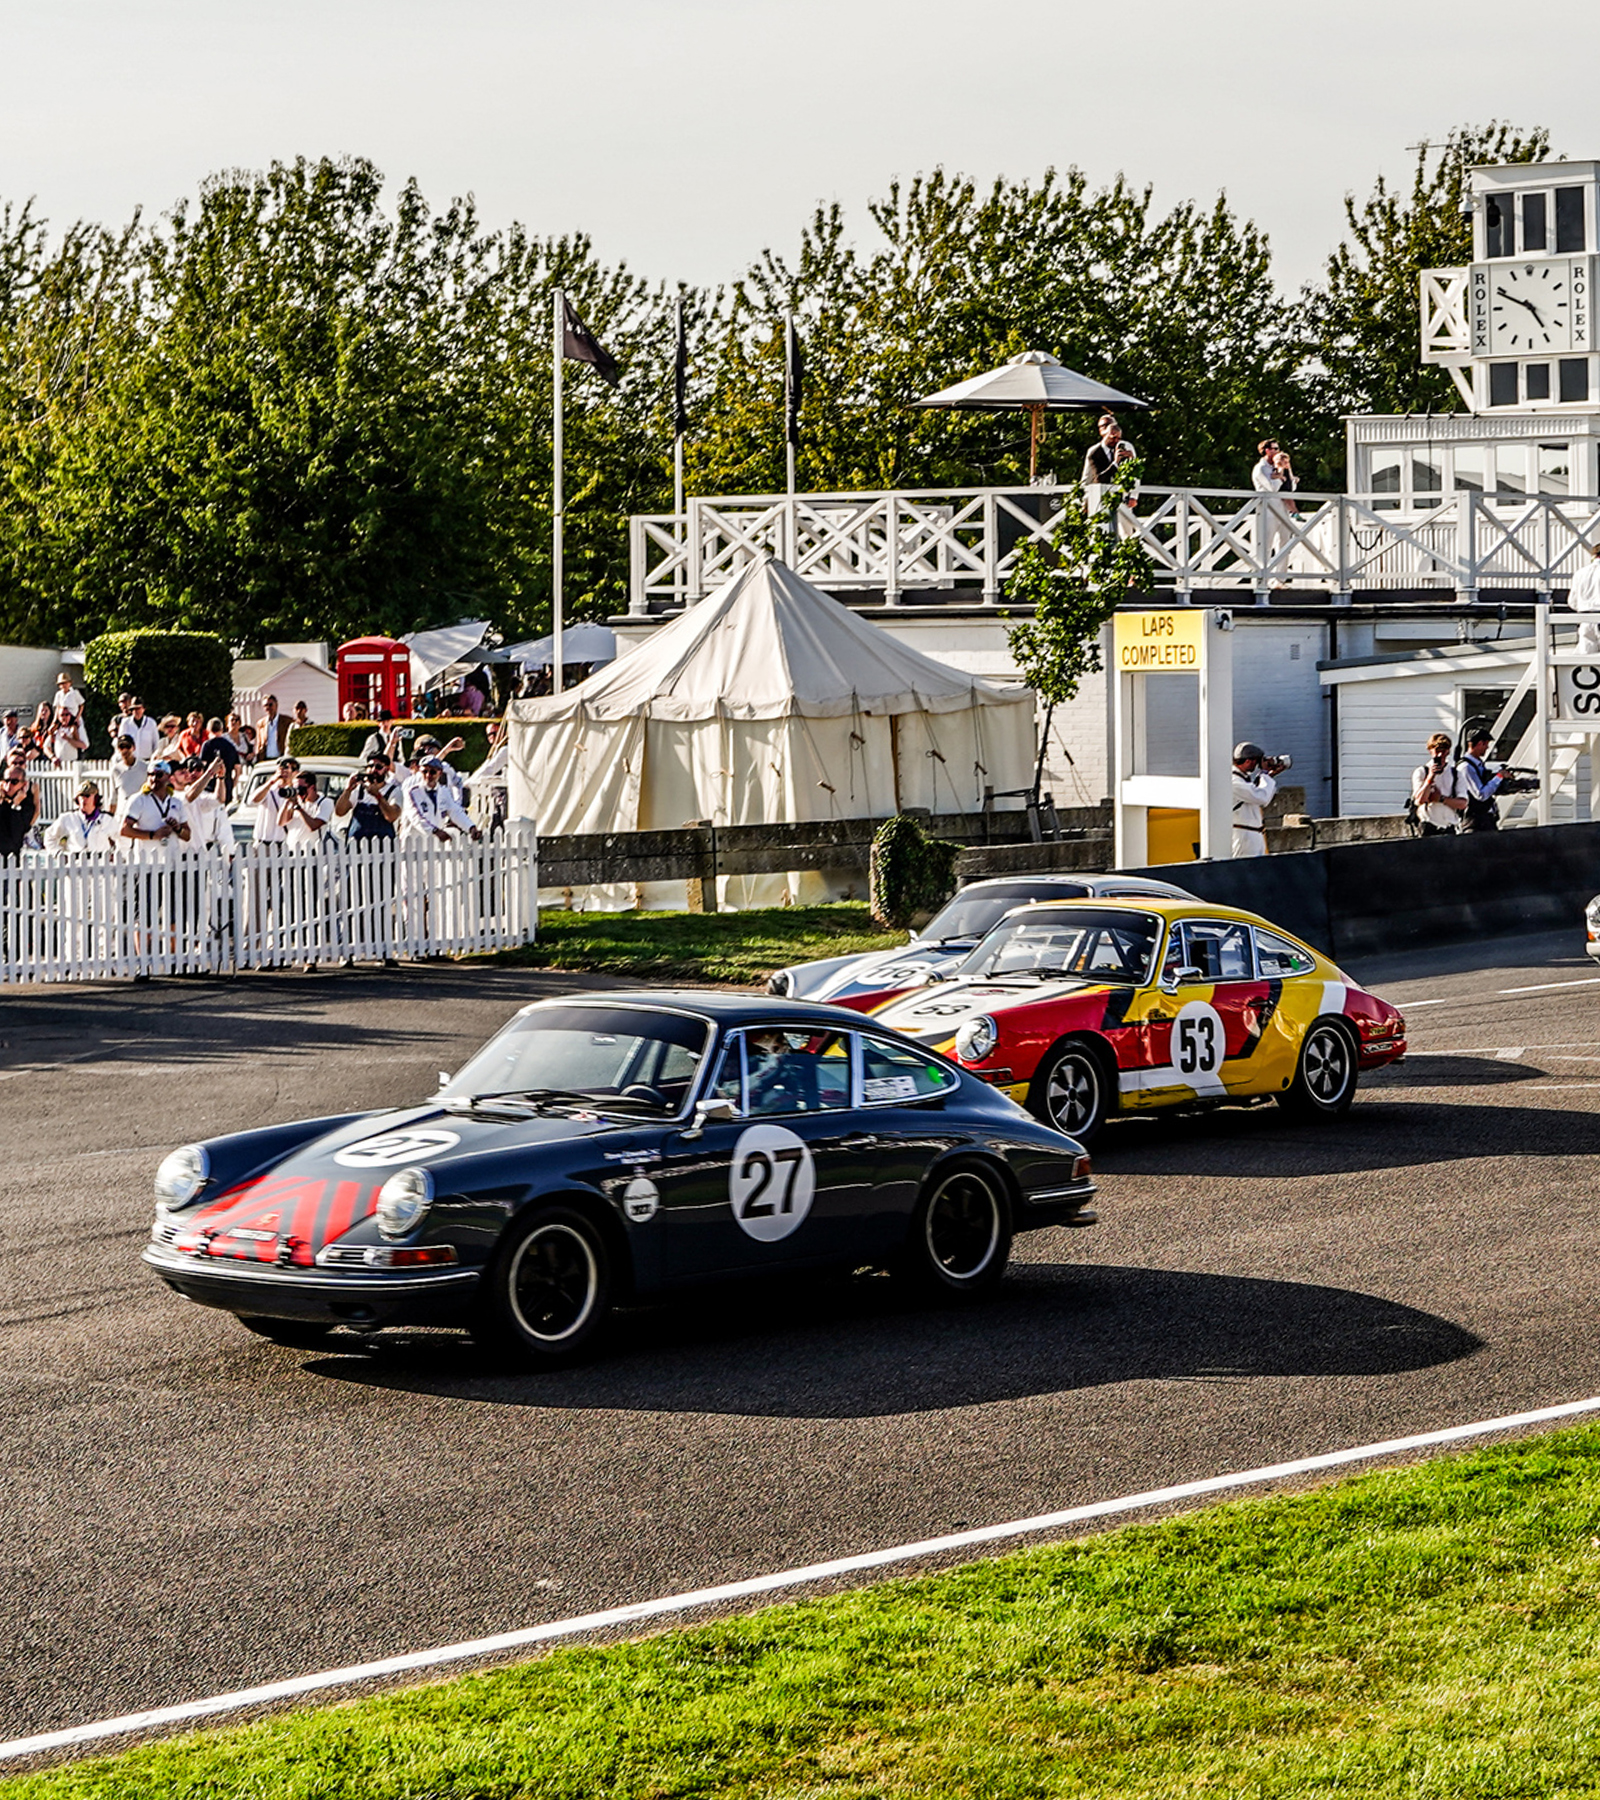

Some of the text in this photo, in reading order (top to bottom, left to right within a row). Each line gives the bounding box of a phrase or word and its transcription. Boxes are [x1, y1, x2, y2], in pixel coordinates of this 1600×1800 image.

[1475, 273, 1487, 347] ROLEX
[1574, 267, 1586, 341] ROLEX
[1142, 616, 1174, 636] LAPS
[1122, 645, 1196, 665] COMPLETED
[913, 1003, 972, 1015] 53
[1179, 1017, 1215, 1073] 53
[345, 1136, 449, 1159] 27
[740, 1146, 804, 1219] 27
